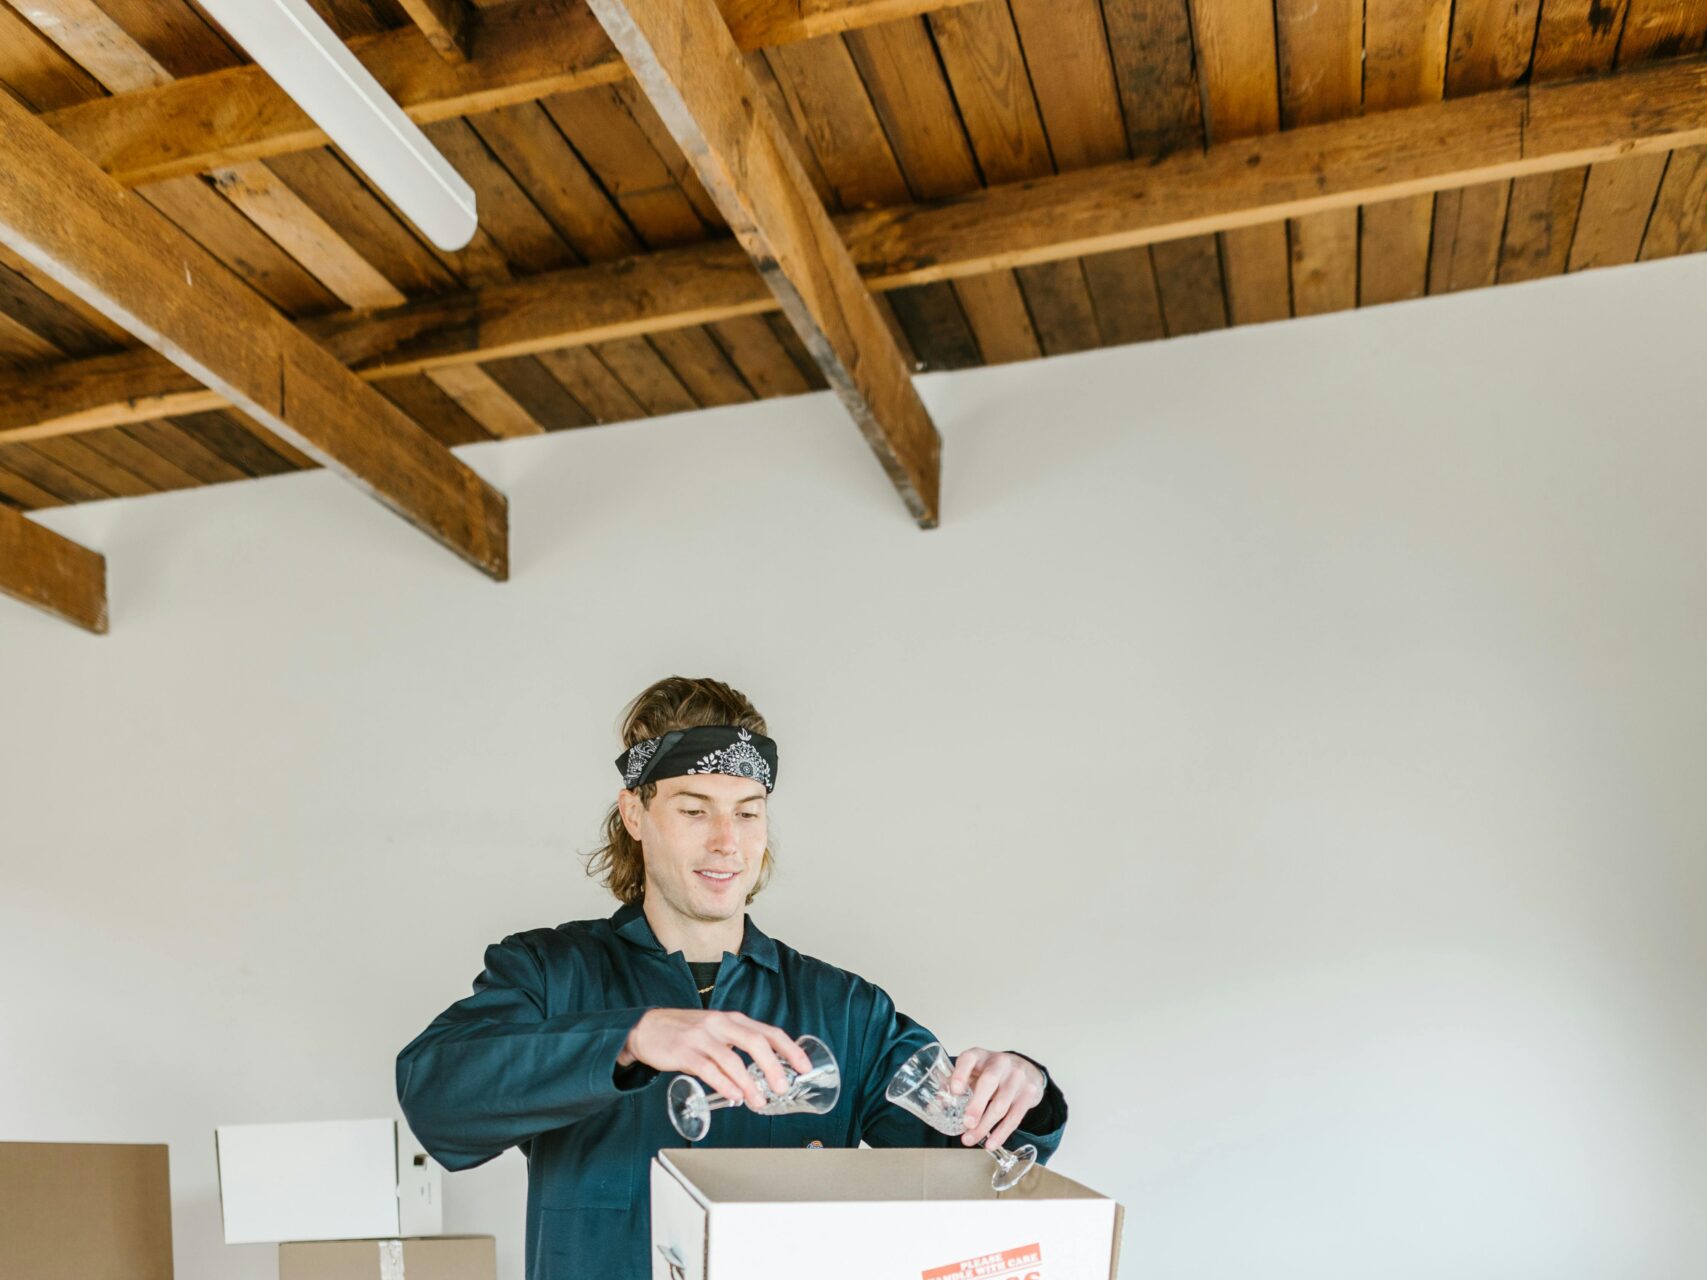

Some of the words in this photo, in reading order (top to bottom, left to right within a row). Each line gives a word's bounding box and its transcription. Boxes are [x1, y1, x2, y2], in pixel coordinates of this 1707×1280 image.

[960, 1253, 1003, 1271] PLEASE
[975, 1262, 1006, 1277] WITH
[1007, 1253, 1039, 1268] CARE
